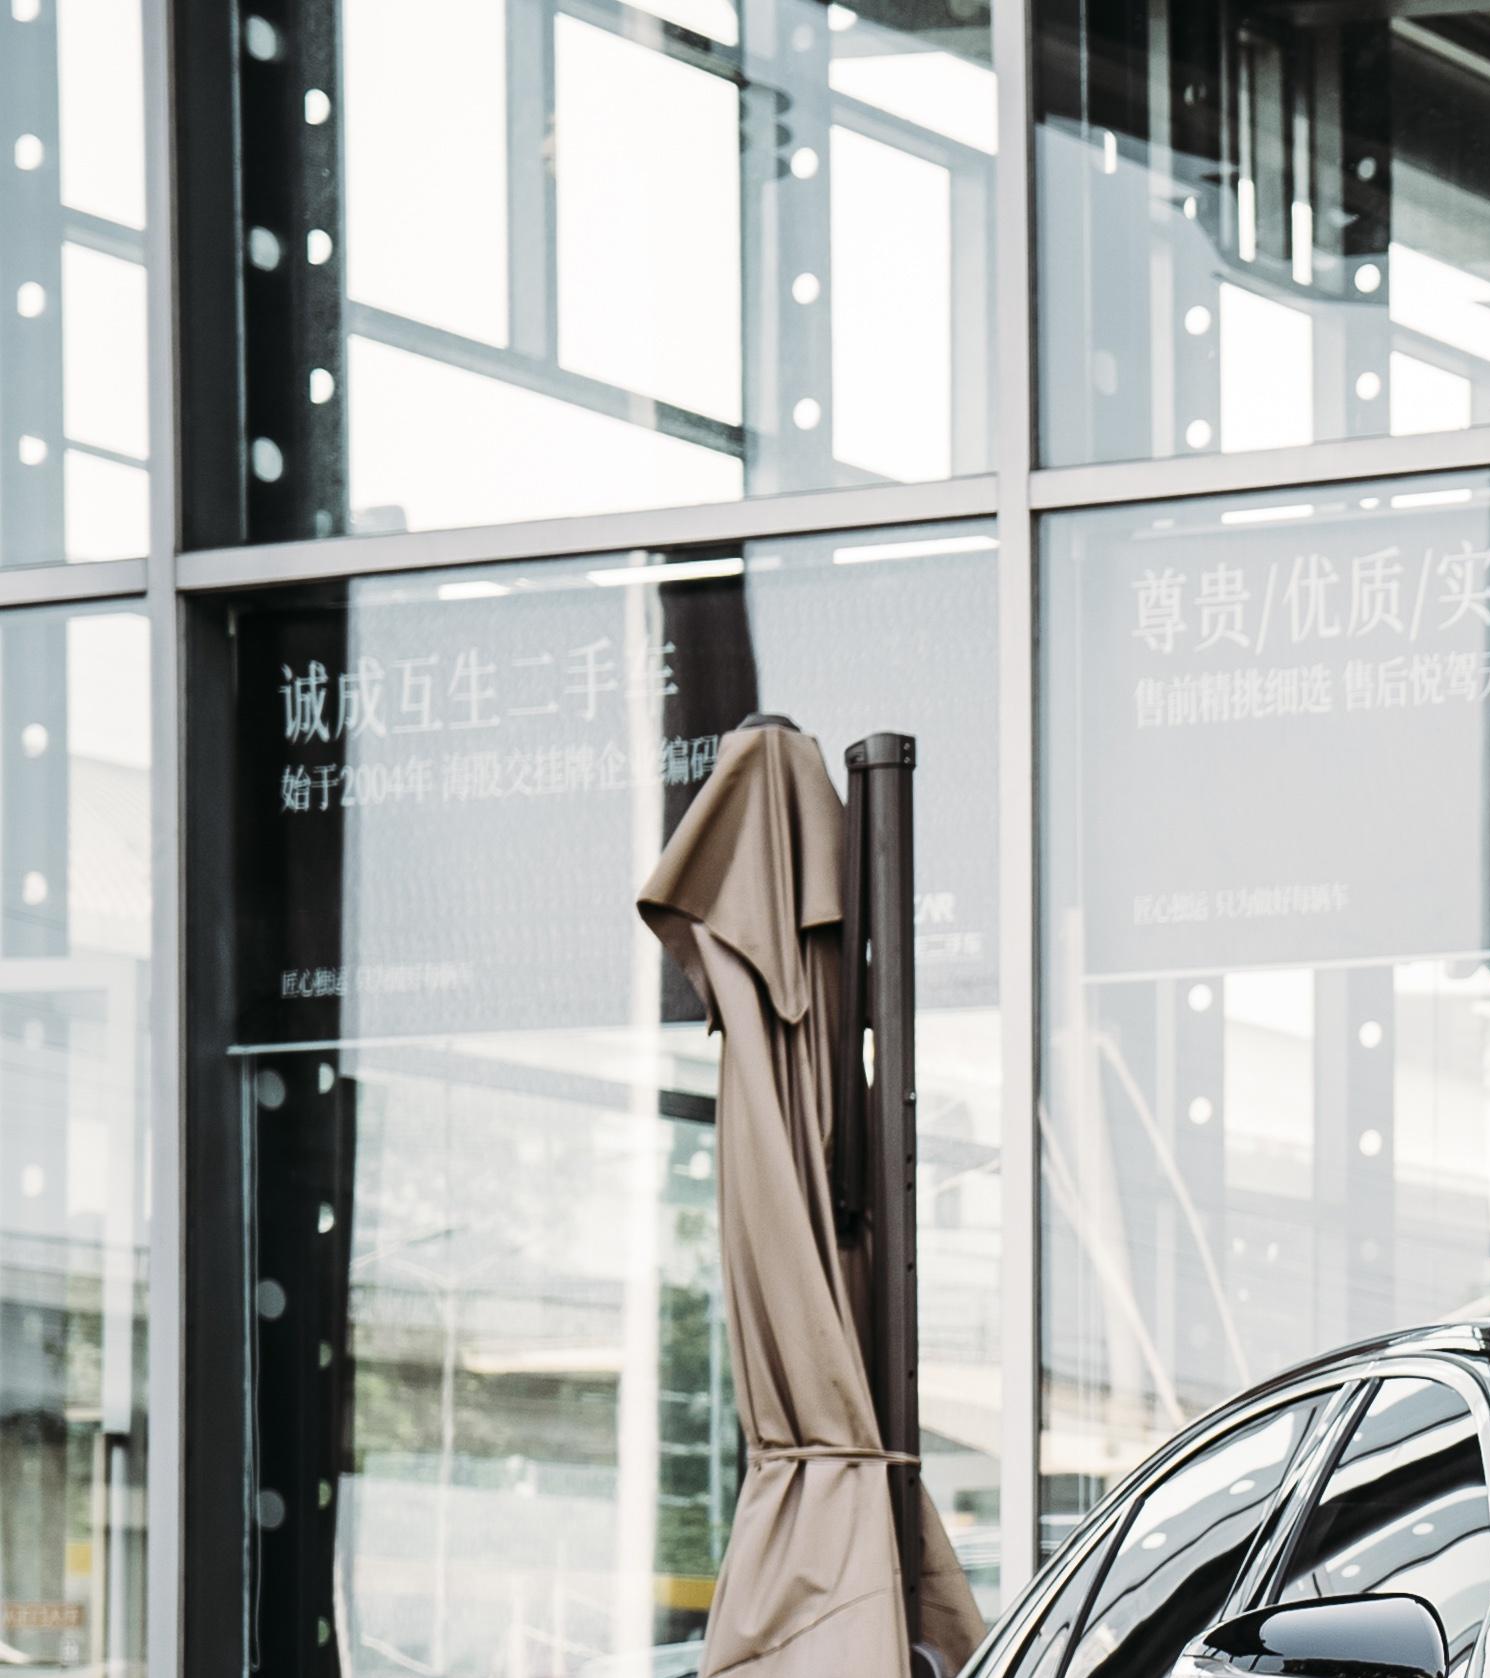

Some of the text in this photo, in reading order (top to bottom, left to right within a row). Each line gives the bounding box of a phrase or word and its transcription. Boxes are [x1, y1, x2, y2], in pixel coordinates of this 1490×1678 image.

[280, 636, 679, 743] 诚成互生二手车
[1134, 666, 1332, 729] 售前精挑细选
